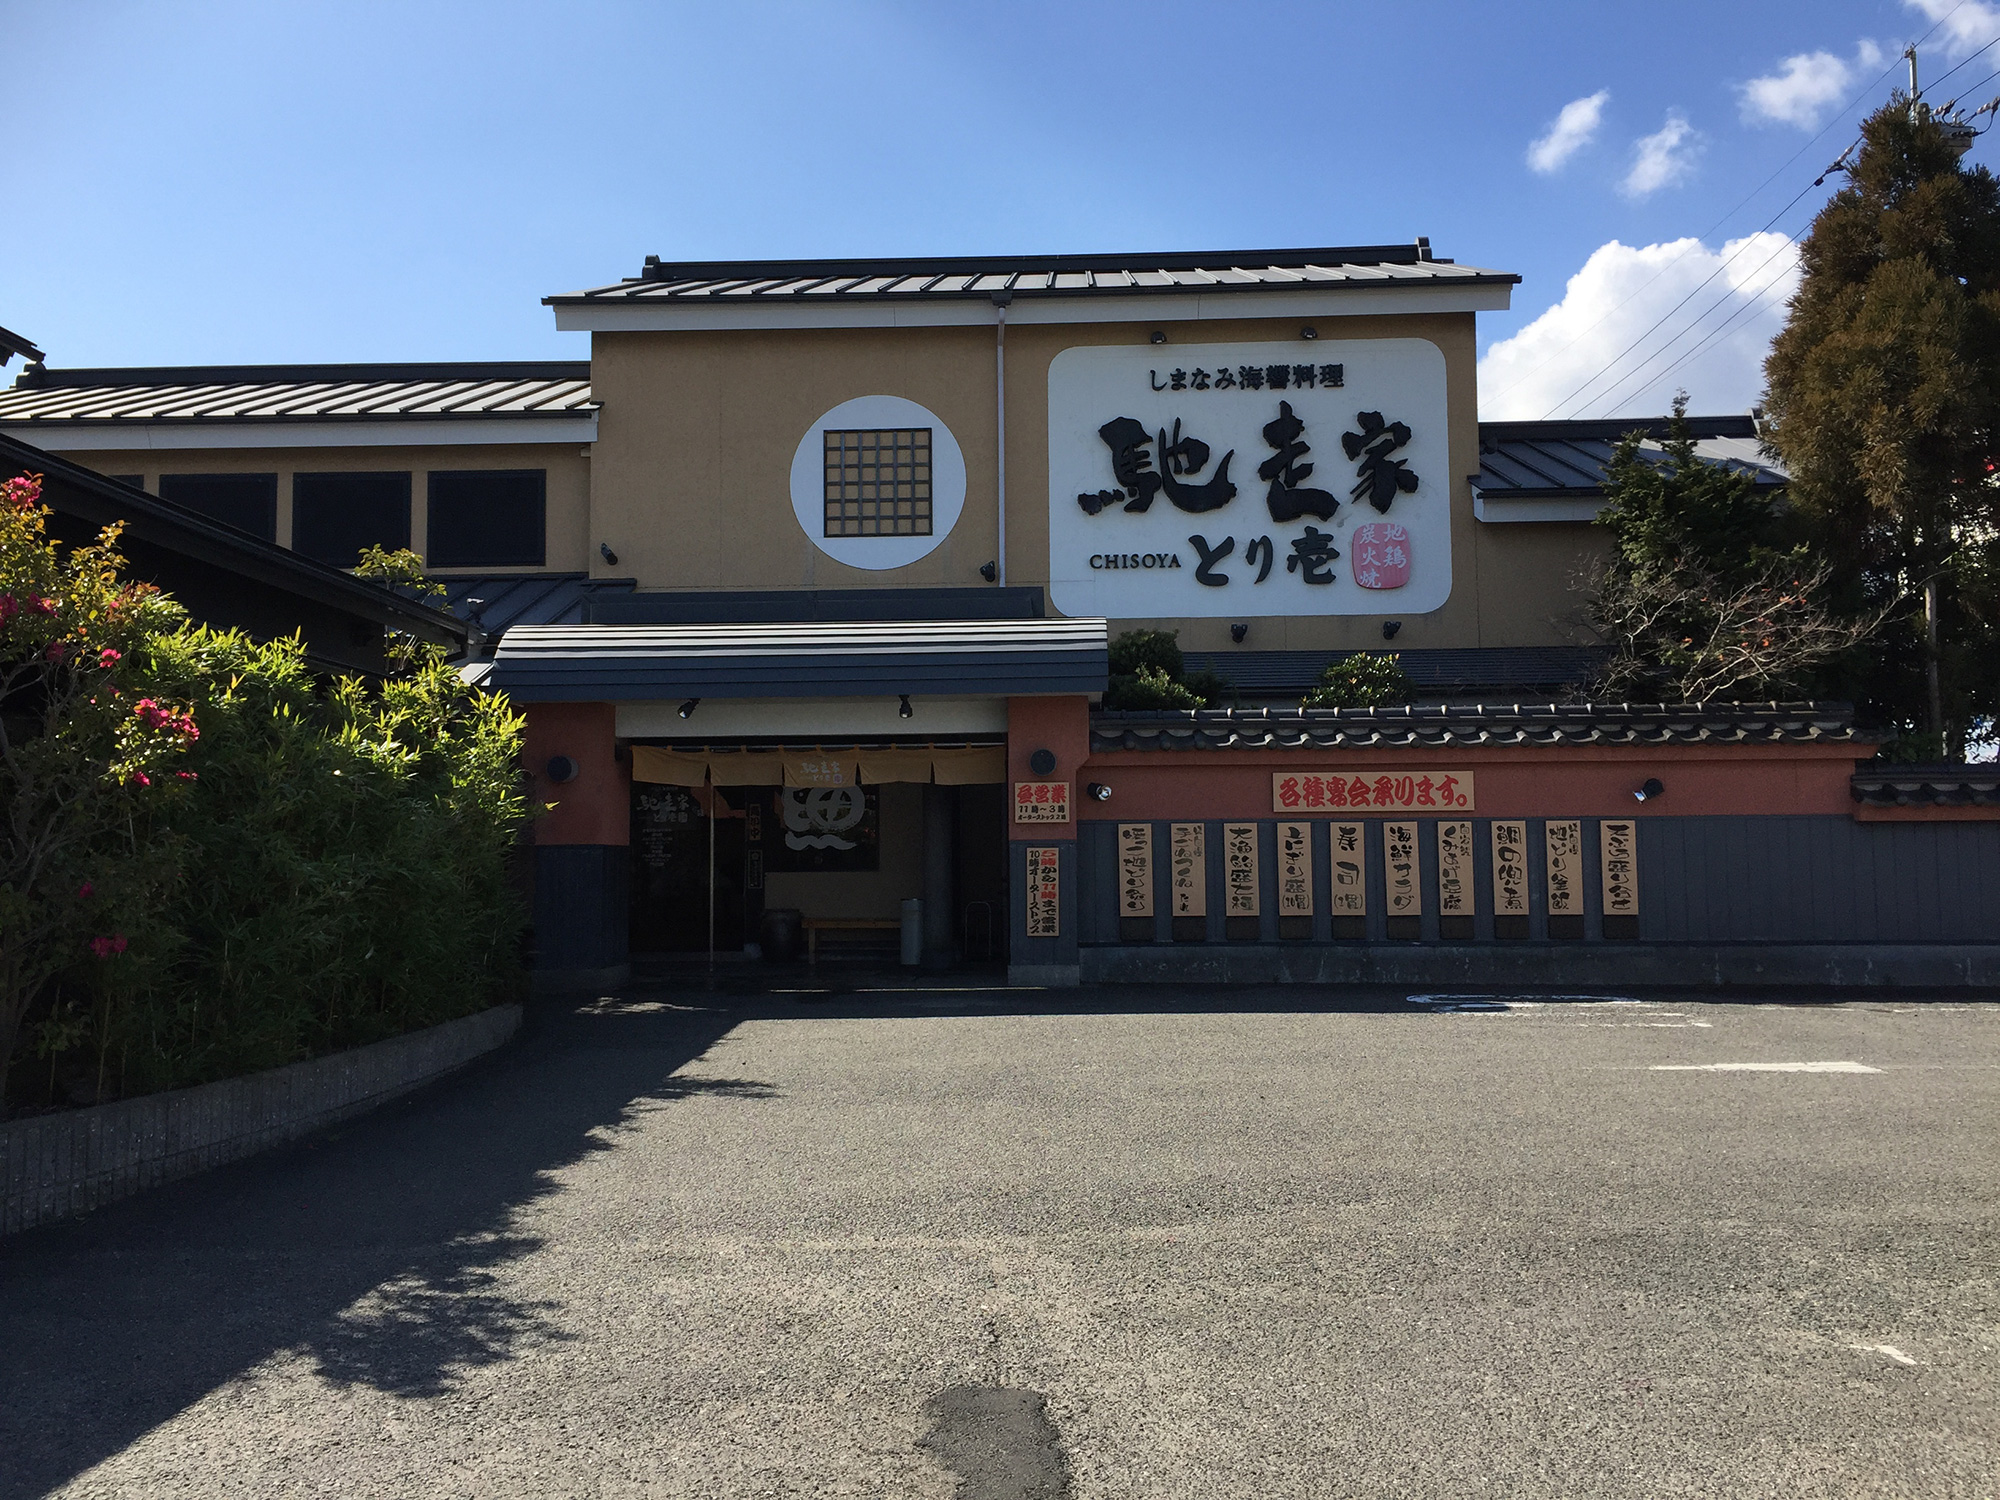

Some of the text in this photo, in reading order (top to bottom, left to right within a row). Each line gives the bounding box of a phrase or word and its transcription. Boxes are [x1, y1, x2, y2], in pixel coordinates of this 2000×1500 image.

[1077, 400, 1420, 522] 馳走家
[1089, 552, 1182, 570] CHISOYA
[1188, 525, 1341, 587] とり壱
[1359, 524, 1381, 588] 炭火焼
[1383, 524, 1407, 568] 地鶏
[1017, 784, 1067, 804] 昼営業
[1279, 774, 1468, 808] 各種宴会承ります。
[1389, 826, 1415, 911] 海鮮サラダ
